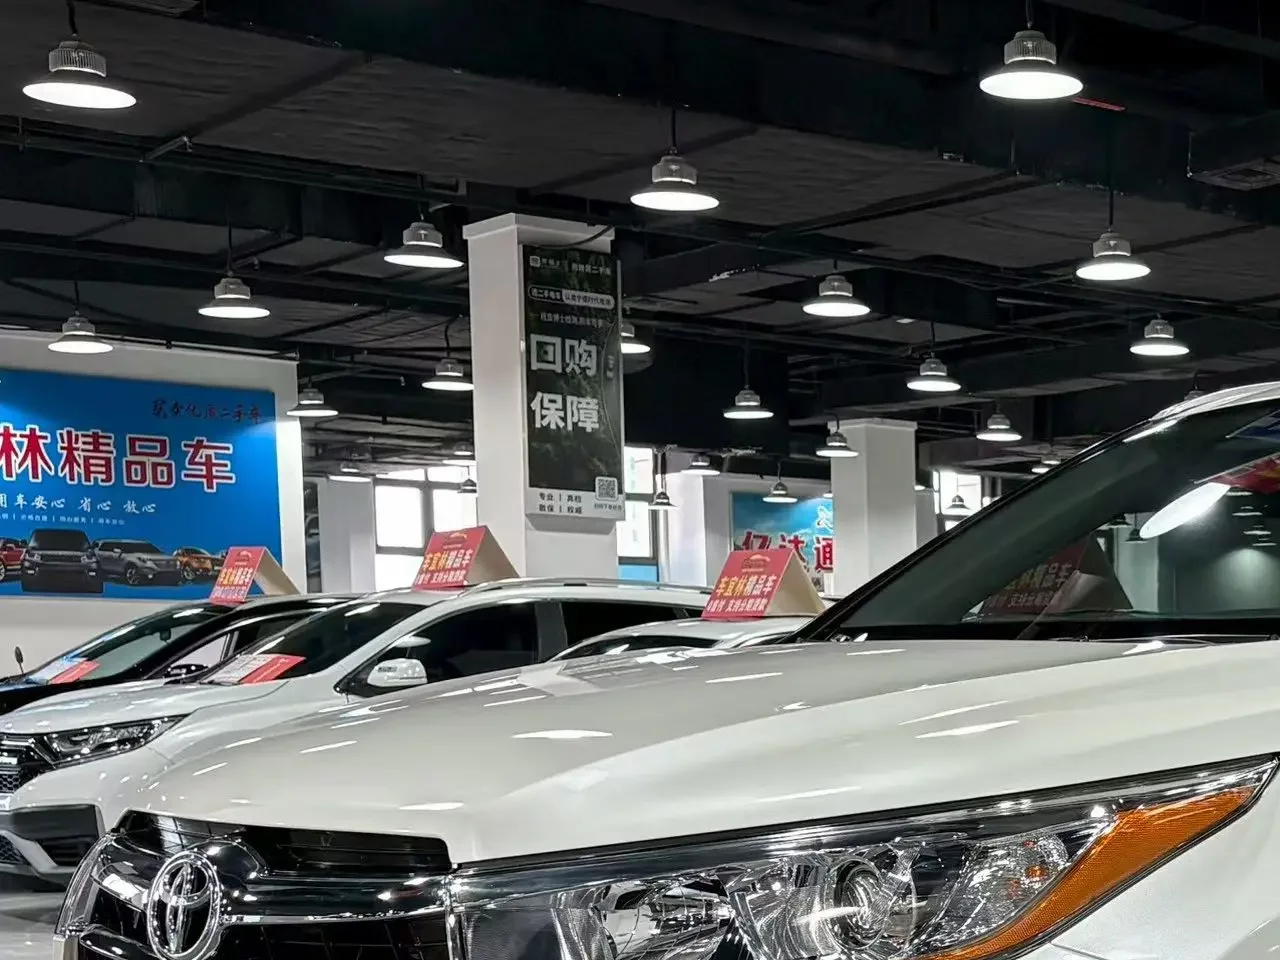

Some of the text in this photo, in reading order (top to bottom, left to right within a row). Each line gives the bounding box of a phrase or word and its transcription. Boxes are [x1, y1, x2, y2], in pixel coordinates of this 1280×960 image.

[529, 333, 597, 377] 回购
[530, 390, 600, 433] 保障
[0, 422, 236, 492] 林精品车
[77, 496, 112, 513] 省心
[123, 500, 157, 514] 放心
